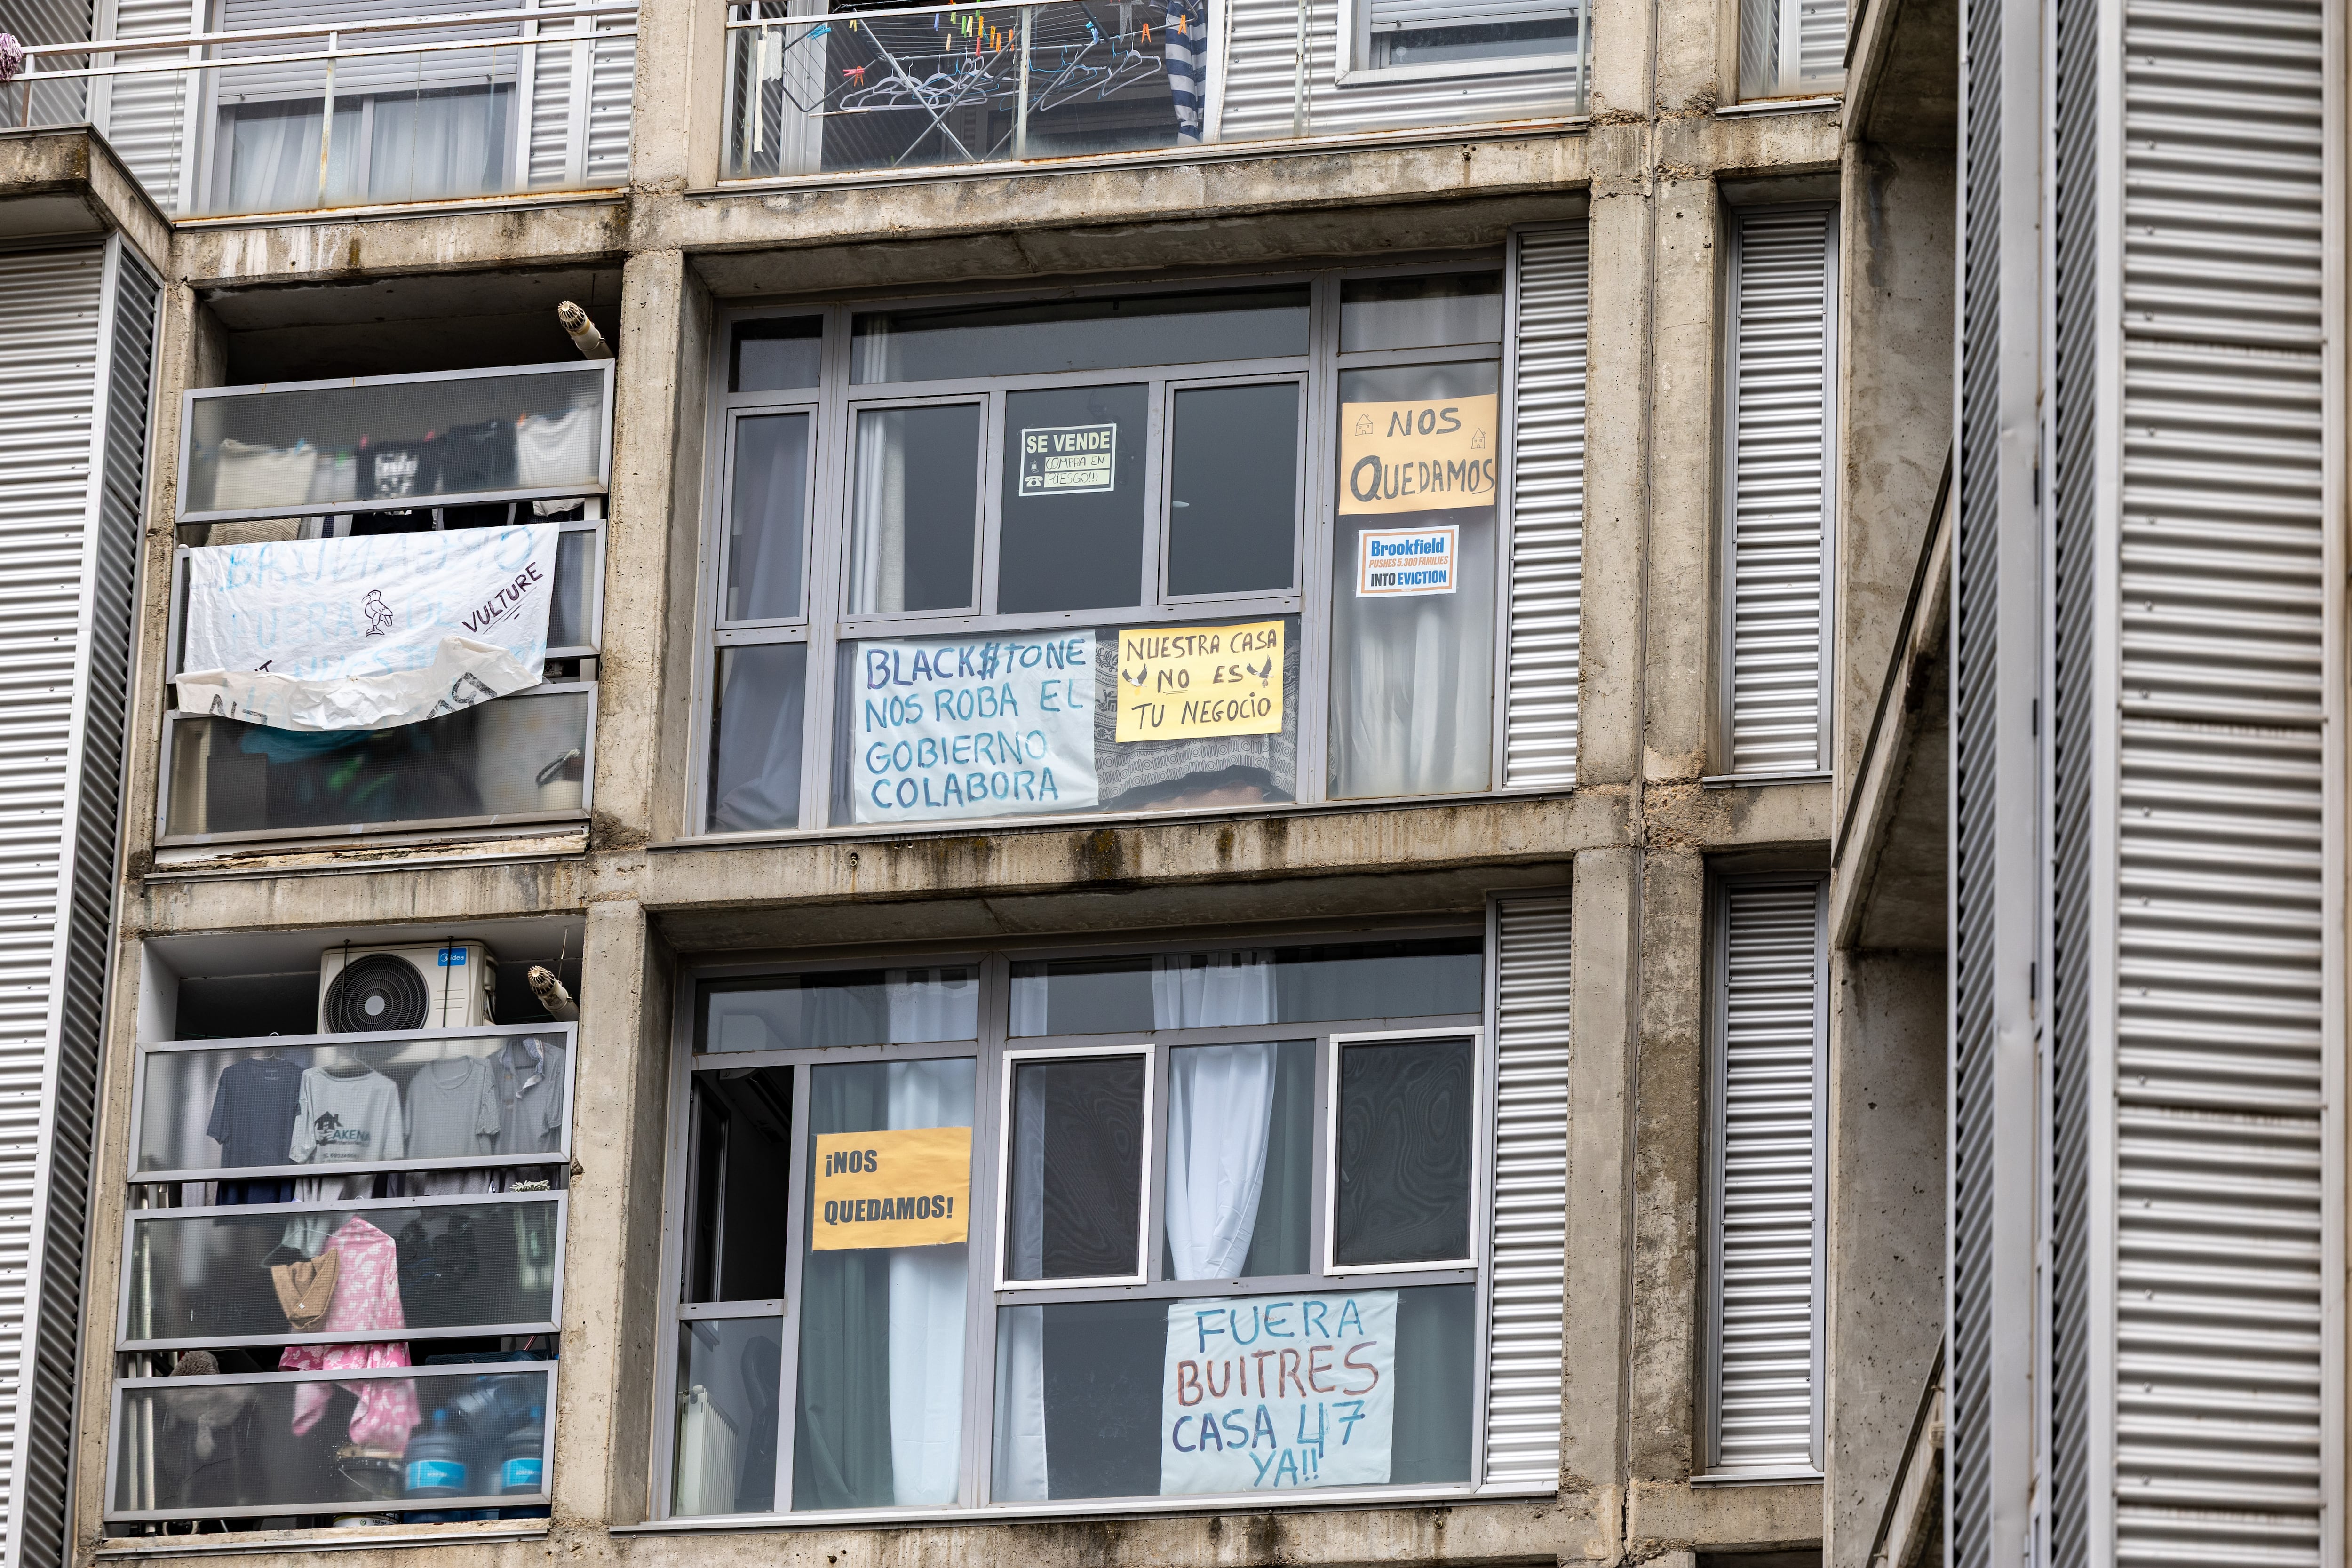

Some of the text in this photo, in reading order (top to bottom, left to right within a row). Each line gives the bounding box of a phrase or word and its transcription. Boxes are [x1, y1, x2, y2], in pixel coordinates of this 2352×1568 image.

[1387, 407, 1461, 437] NOS
[1026, 431, 1110, 453] SE VENDE
[1046, 456, 1105, 470] COMPRA EN
[1350, 455, 1495, 502] QUEDAMOS
[1369, 556, 1448, 568] PUSHES 5.300 FAMILIES
[1371, 537, 1444, 557] Brookfield
[1371, 570, 1446, 587] INTO EVICTION
[461, 561, 544, 633] VULTURE
[1127, 629, 1277, 661] NUESTRA CASA
[1157, 664, 1244, 693] NO ES
[865, 679, 1084, 732] NOS ROBA EL
[1131, 702, 1165, 730] TU
[866, 730, 1047, 775] GOBIERNO
[871, 766, 1058, 809] COLABORA
[826, 1149, 877, 1177] ¡NOS
[824, 1195, 954, 1226] QUEDAMOS!
[1194, 1299, 1364, 1353] FUERA
[1177, 1341, 1379, 1406] BUITRES
[1172, 1400, 1366, 1459] CASA 47
[1249, 1448, 1319, 1487] YA!!
